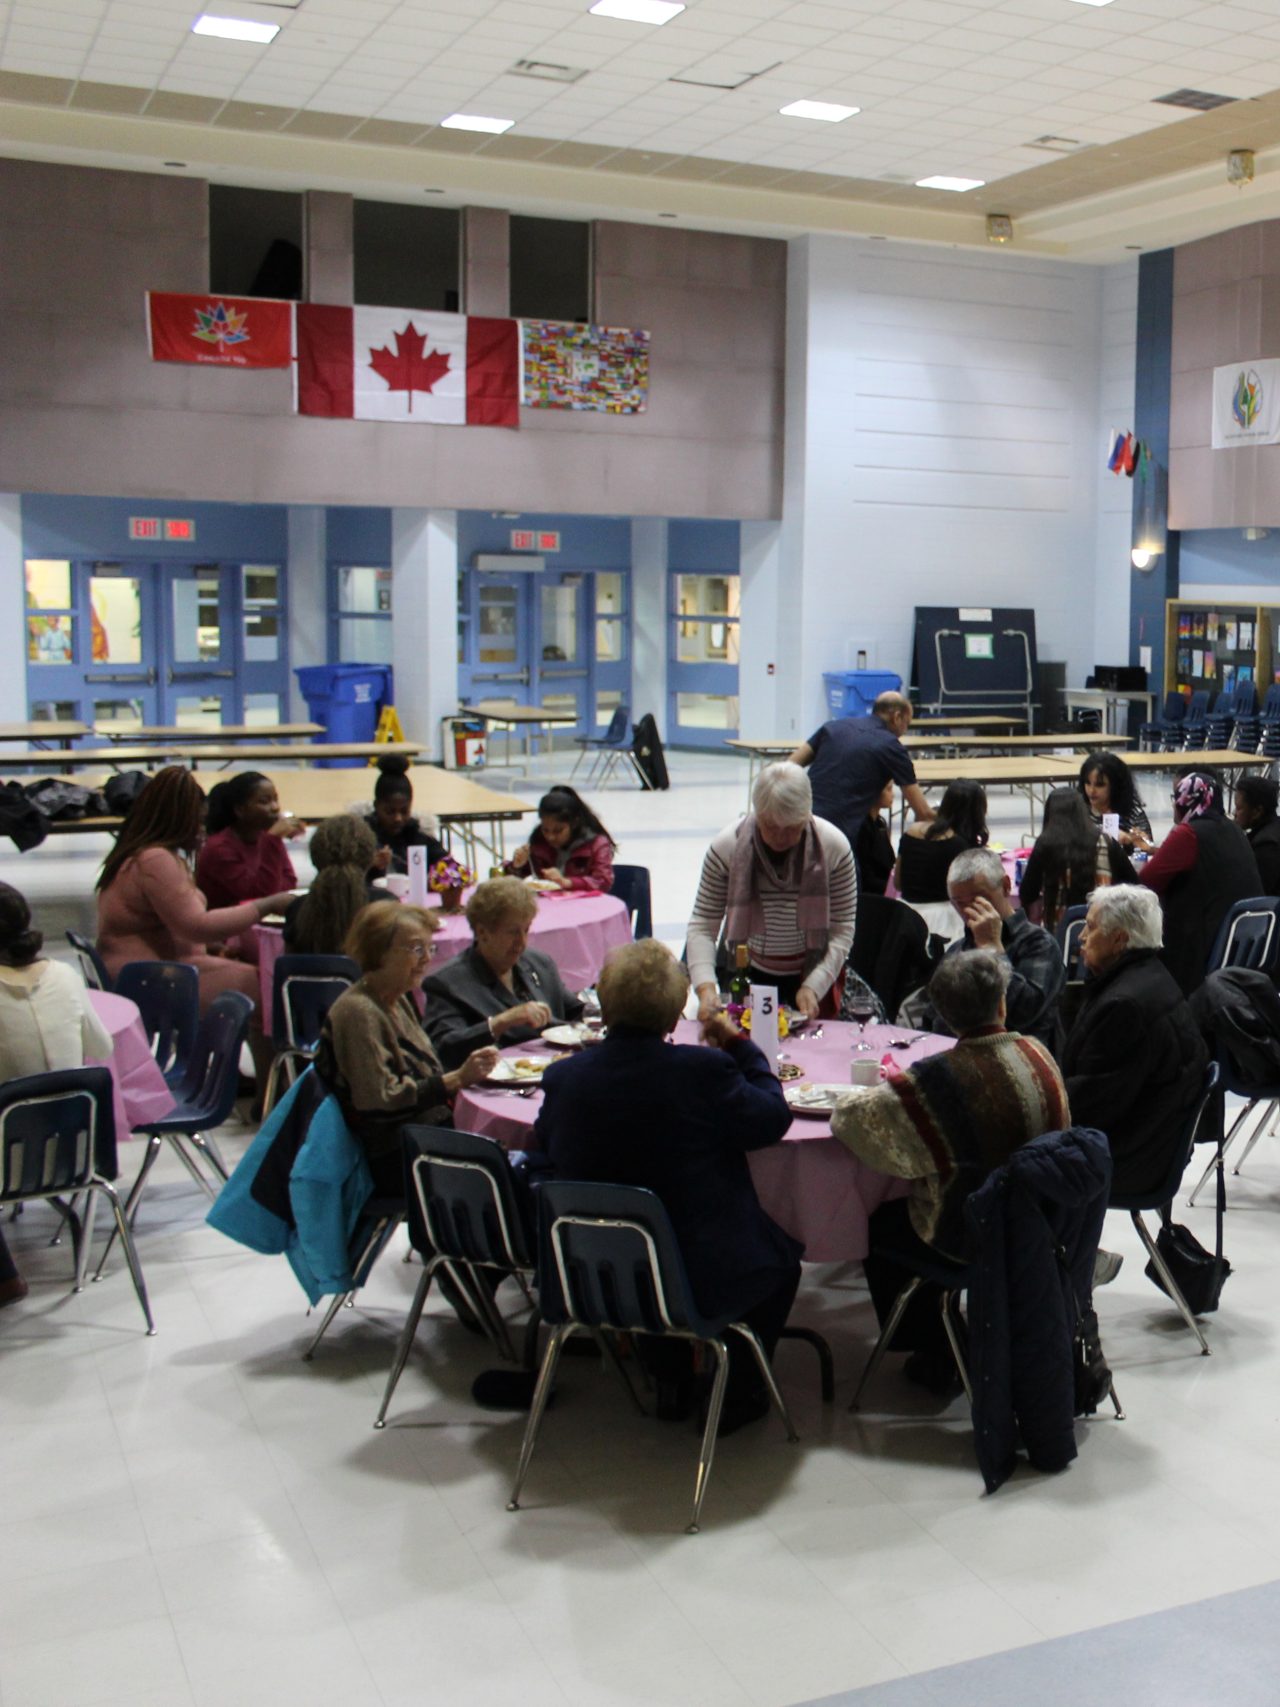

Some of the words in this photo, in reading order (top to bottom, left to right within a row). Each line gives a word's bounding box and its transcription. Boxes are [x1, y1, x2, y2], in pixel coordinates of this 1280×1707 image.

[135, 519, 157, 537] EXIT
[413, 851, 421, 865] 6
[762, 996, 773, 1015] 3
